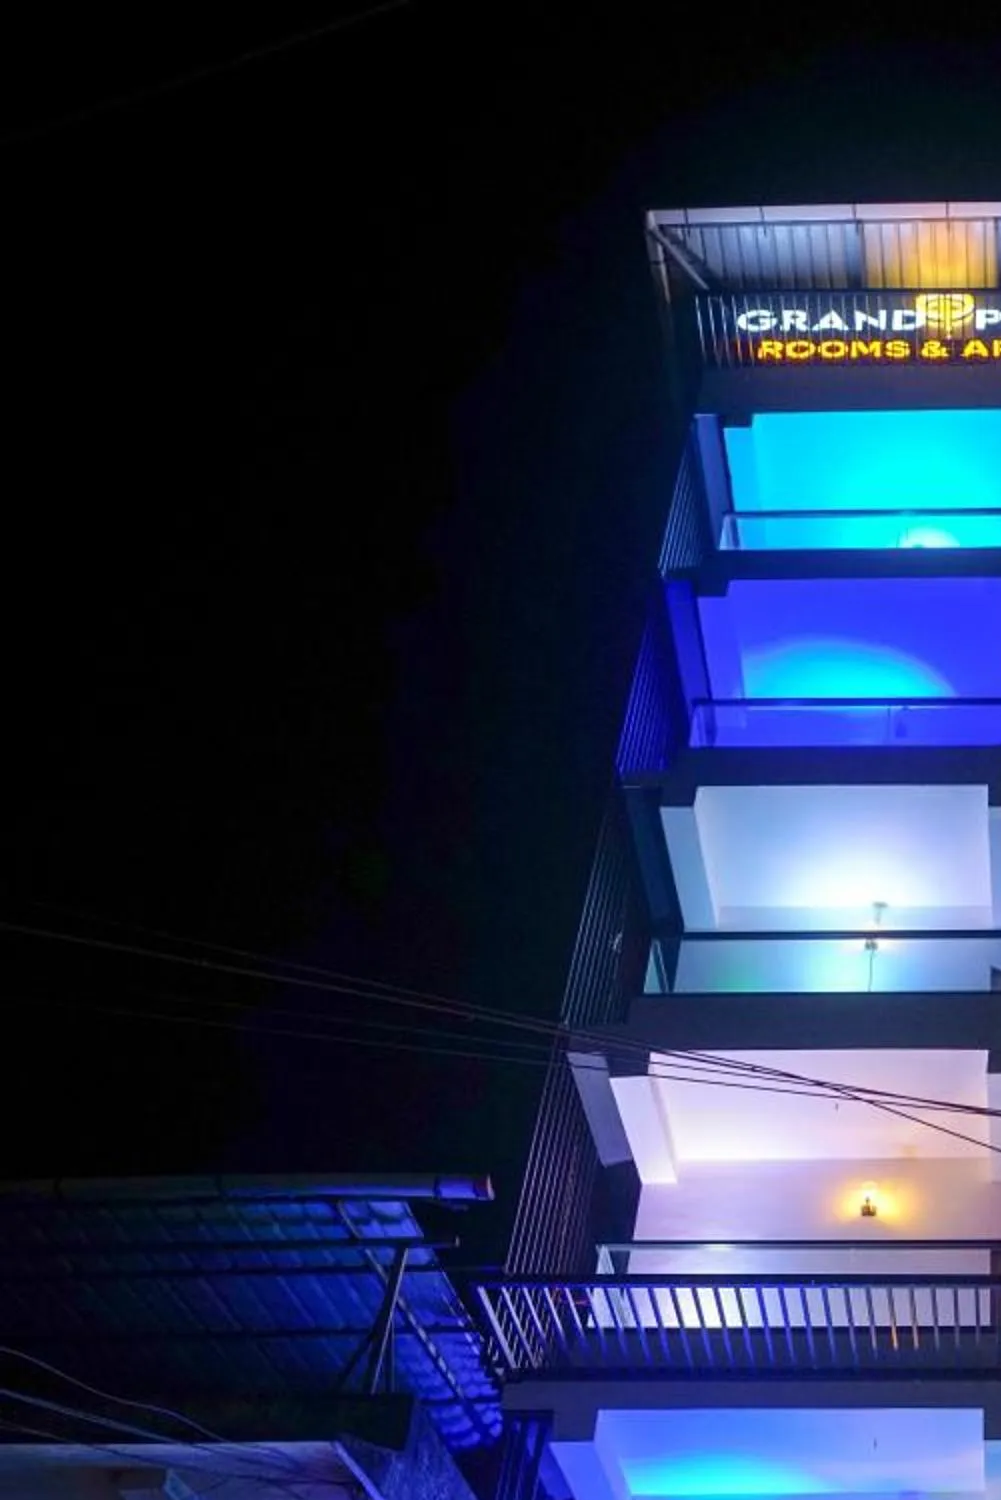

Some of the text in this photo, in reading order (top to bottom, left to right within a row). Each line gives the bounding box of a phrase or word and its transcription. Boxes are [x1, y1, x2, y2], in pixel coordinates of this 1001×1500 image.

[736, 309, 925, 332] GRAND
[757, 340, 910, 360] ROOMS
[920, 340, 949, 360] &
